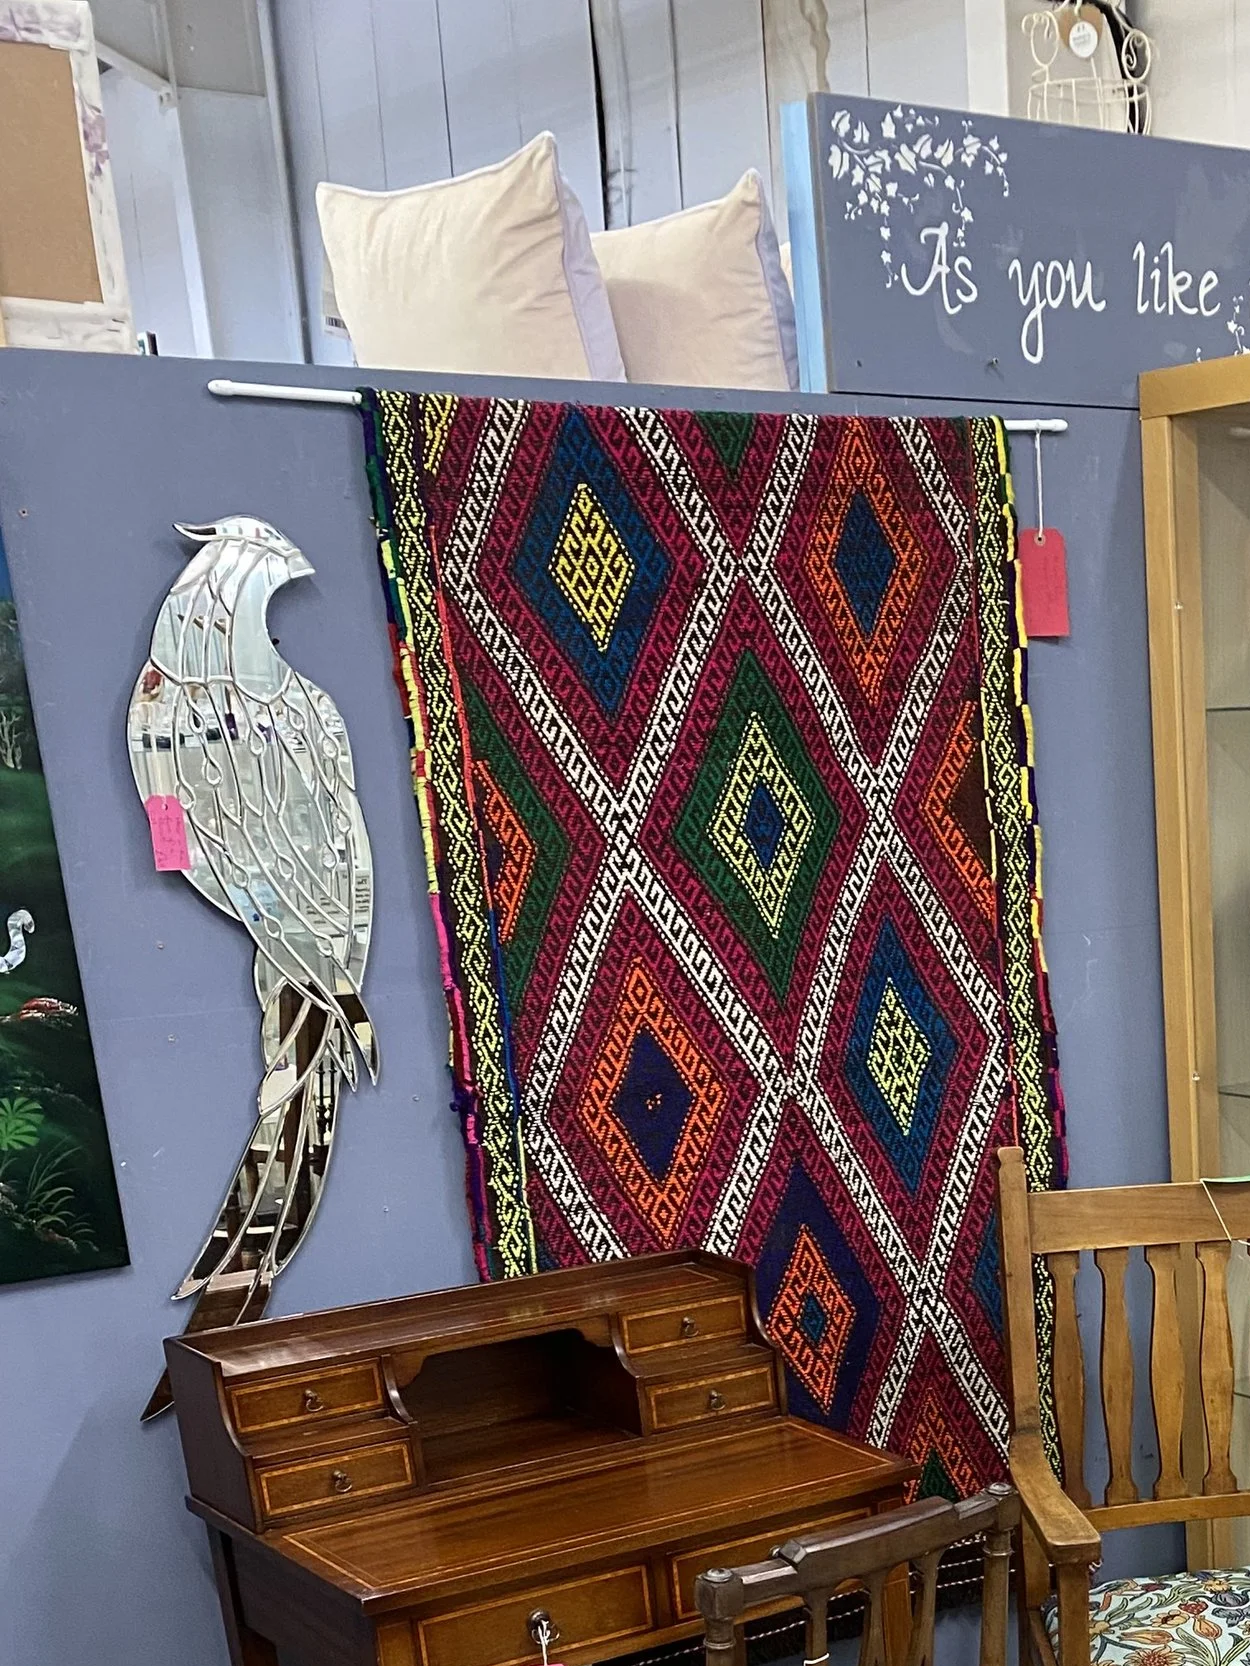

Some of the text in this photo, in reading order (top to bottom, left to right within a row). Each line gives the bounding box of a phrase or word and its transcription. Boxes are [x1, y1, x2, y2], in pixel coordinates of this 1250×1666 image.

[900, 220, 978, 316] As
[1008, 255, 1106, 365] you
[1134, 240, 1221, 318] like
